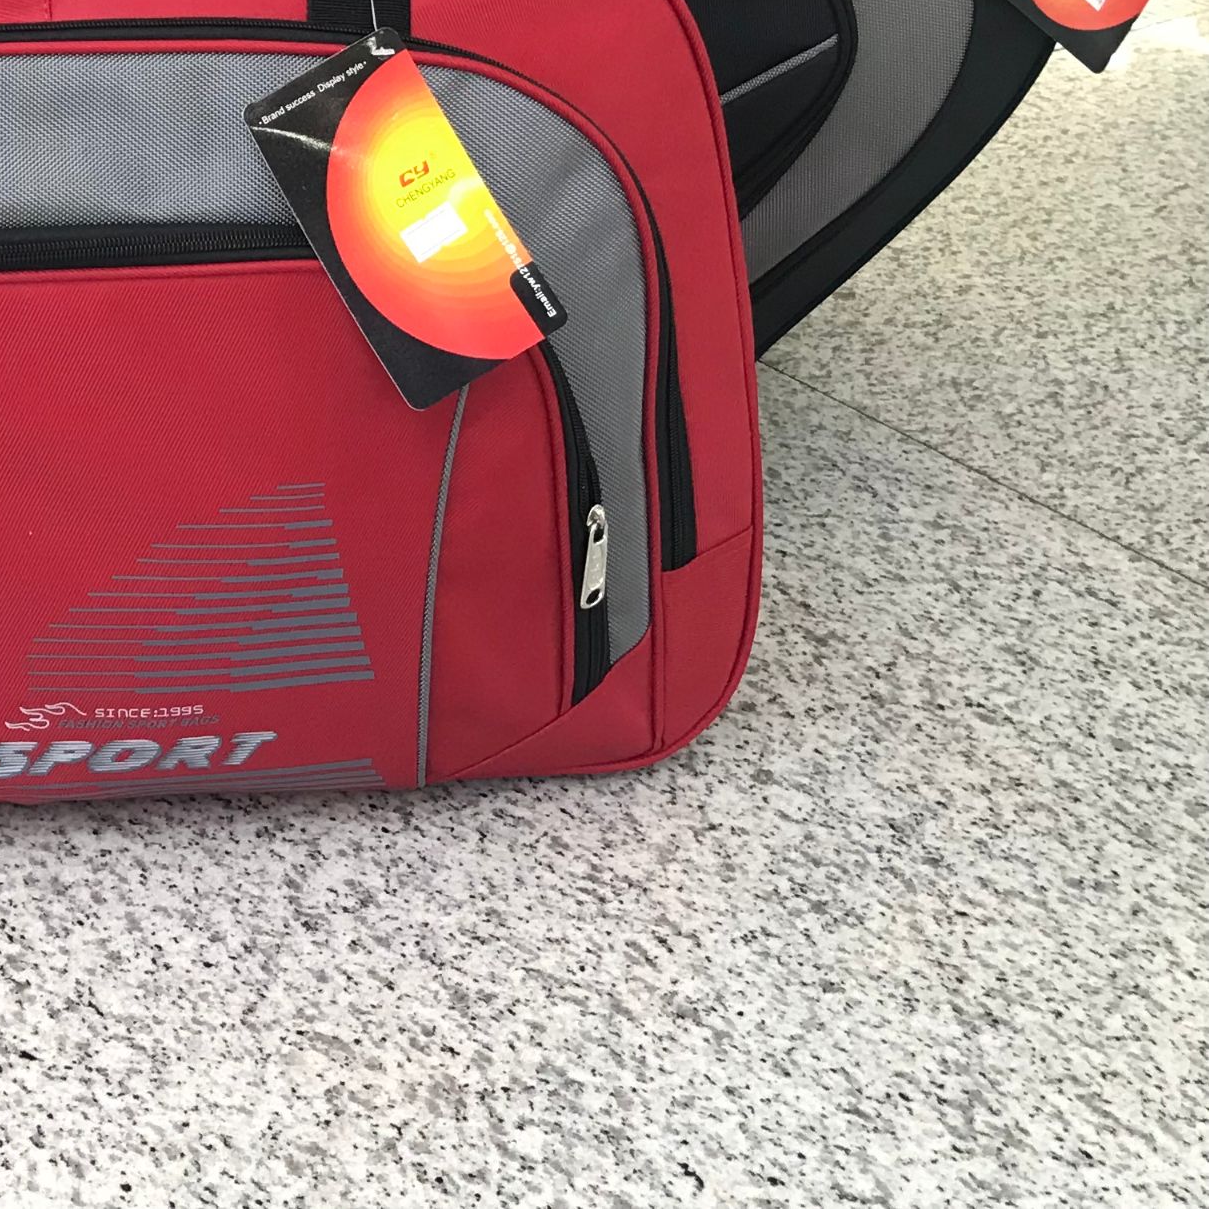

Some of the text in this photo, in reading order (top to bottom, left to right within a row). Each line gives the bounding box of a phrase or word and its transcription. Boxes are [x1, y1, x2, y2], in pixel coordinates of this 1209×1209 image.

[261, 62, 364, 125] Brand success Display style
[395, 168, 456, 209] CHENGYANG
[94, 704, 204, 718] SINCE:1995
